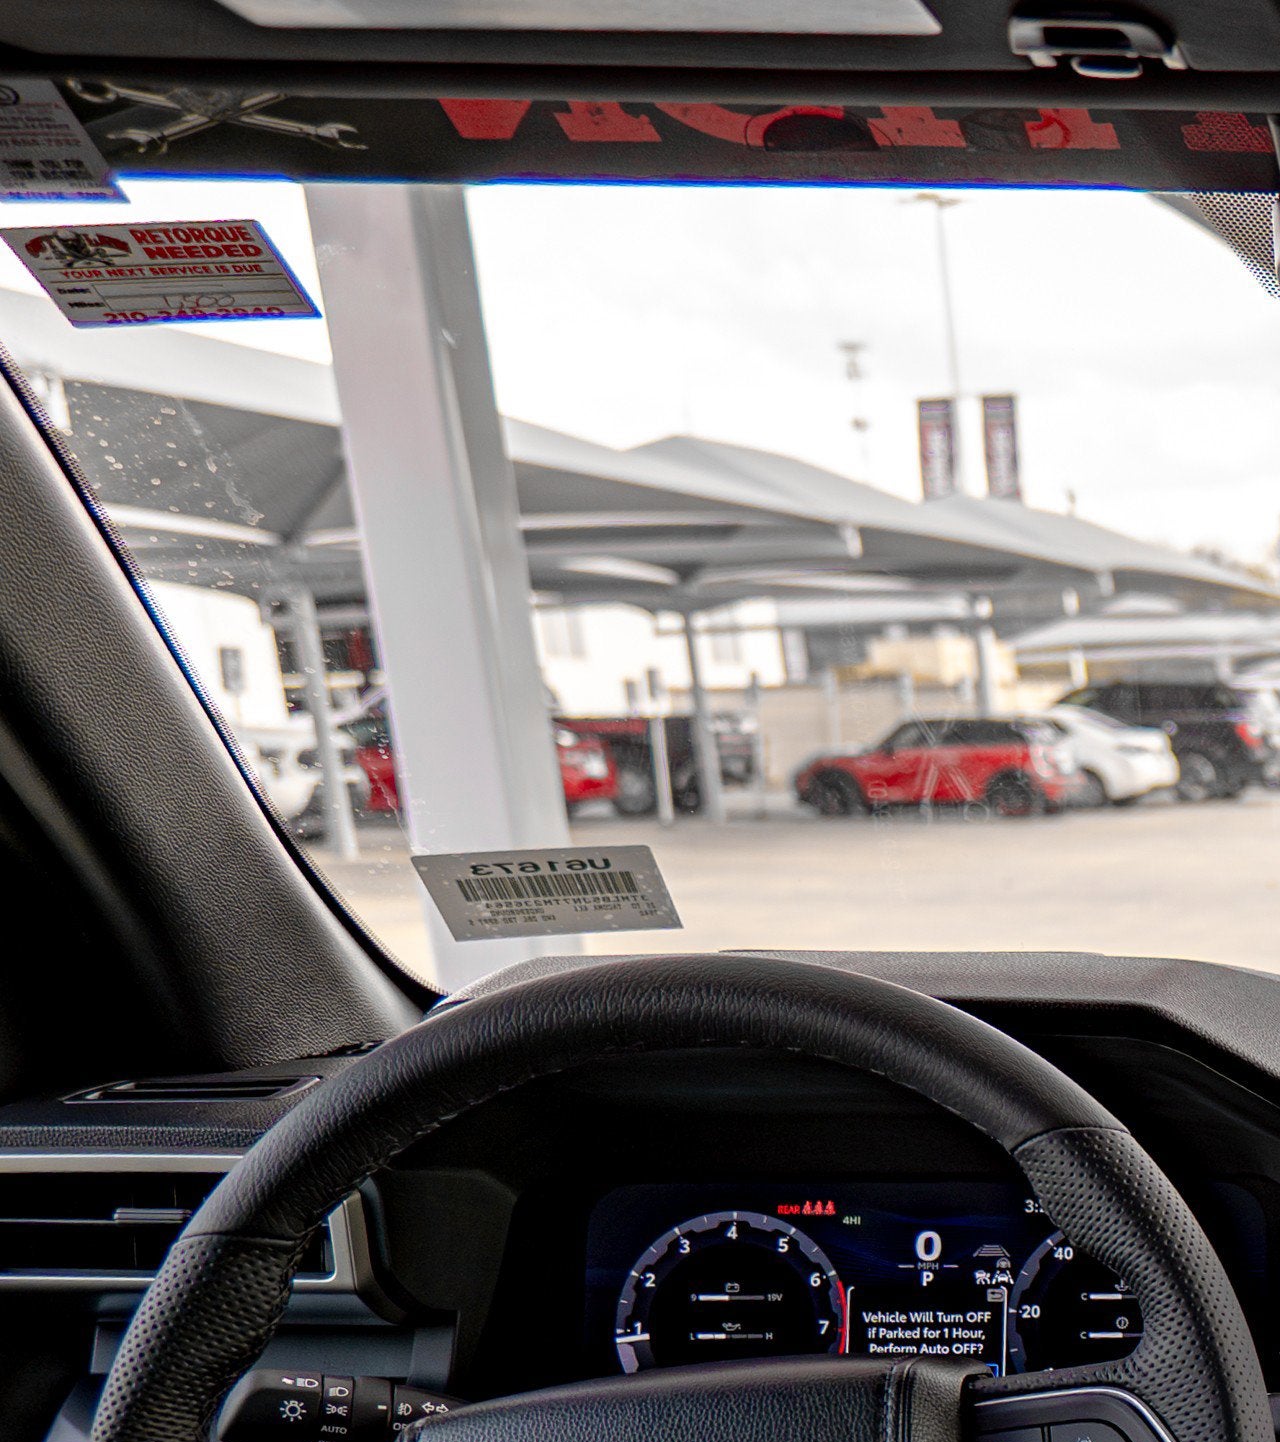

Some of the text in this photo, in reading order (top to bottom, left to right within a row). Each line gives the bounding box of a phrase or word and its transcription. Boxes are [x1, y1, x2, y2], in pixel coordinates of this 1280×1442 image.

[130, 225, 255, 245] RETORQUE
[142, 243, 264, 260] NEEDED
[59, 263, 264, 280] YOUR NEXT SERVICE IS DUE
[727, 1225, 738, 1240] 4
[679, 1238, 691, 1253] 3
[778, 1238, 789, 1253] 5
[915, 1230, 942, 1261] 0
[1054, 1247, 1074, 1260] 40
[917, 1262, 939, 1270] MPH
[645, 1273, 656, 1287] 2
[810, 1273, 821, 1287] 6
[922, 1272, 934, 1286] P
[862, 1311, 991, 1323] Vehicle Will Turn OFF
[1021, 1305, 1041, 1319] 20
[634, 1321, 642, 1335] 1
[818, 1320, 829, 1335] 7
[868, 1327, 986, 1340] if Parked for 1 Hour,
[870, 1343, 983, 1354] Perform Auto OFF?
[321, 1424, 347, 1435] AUTO
